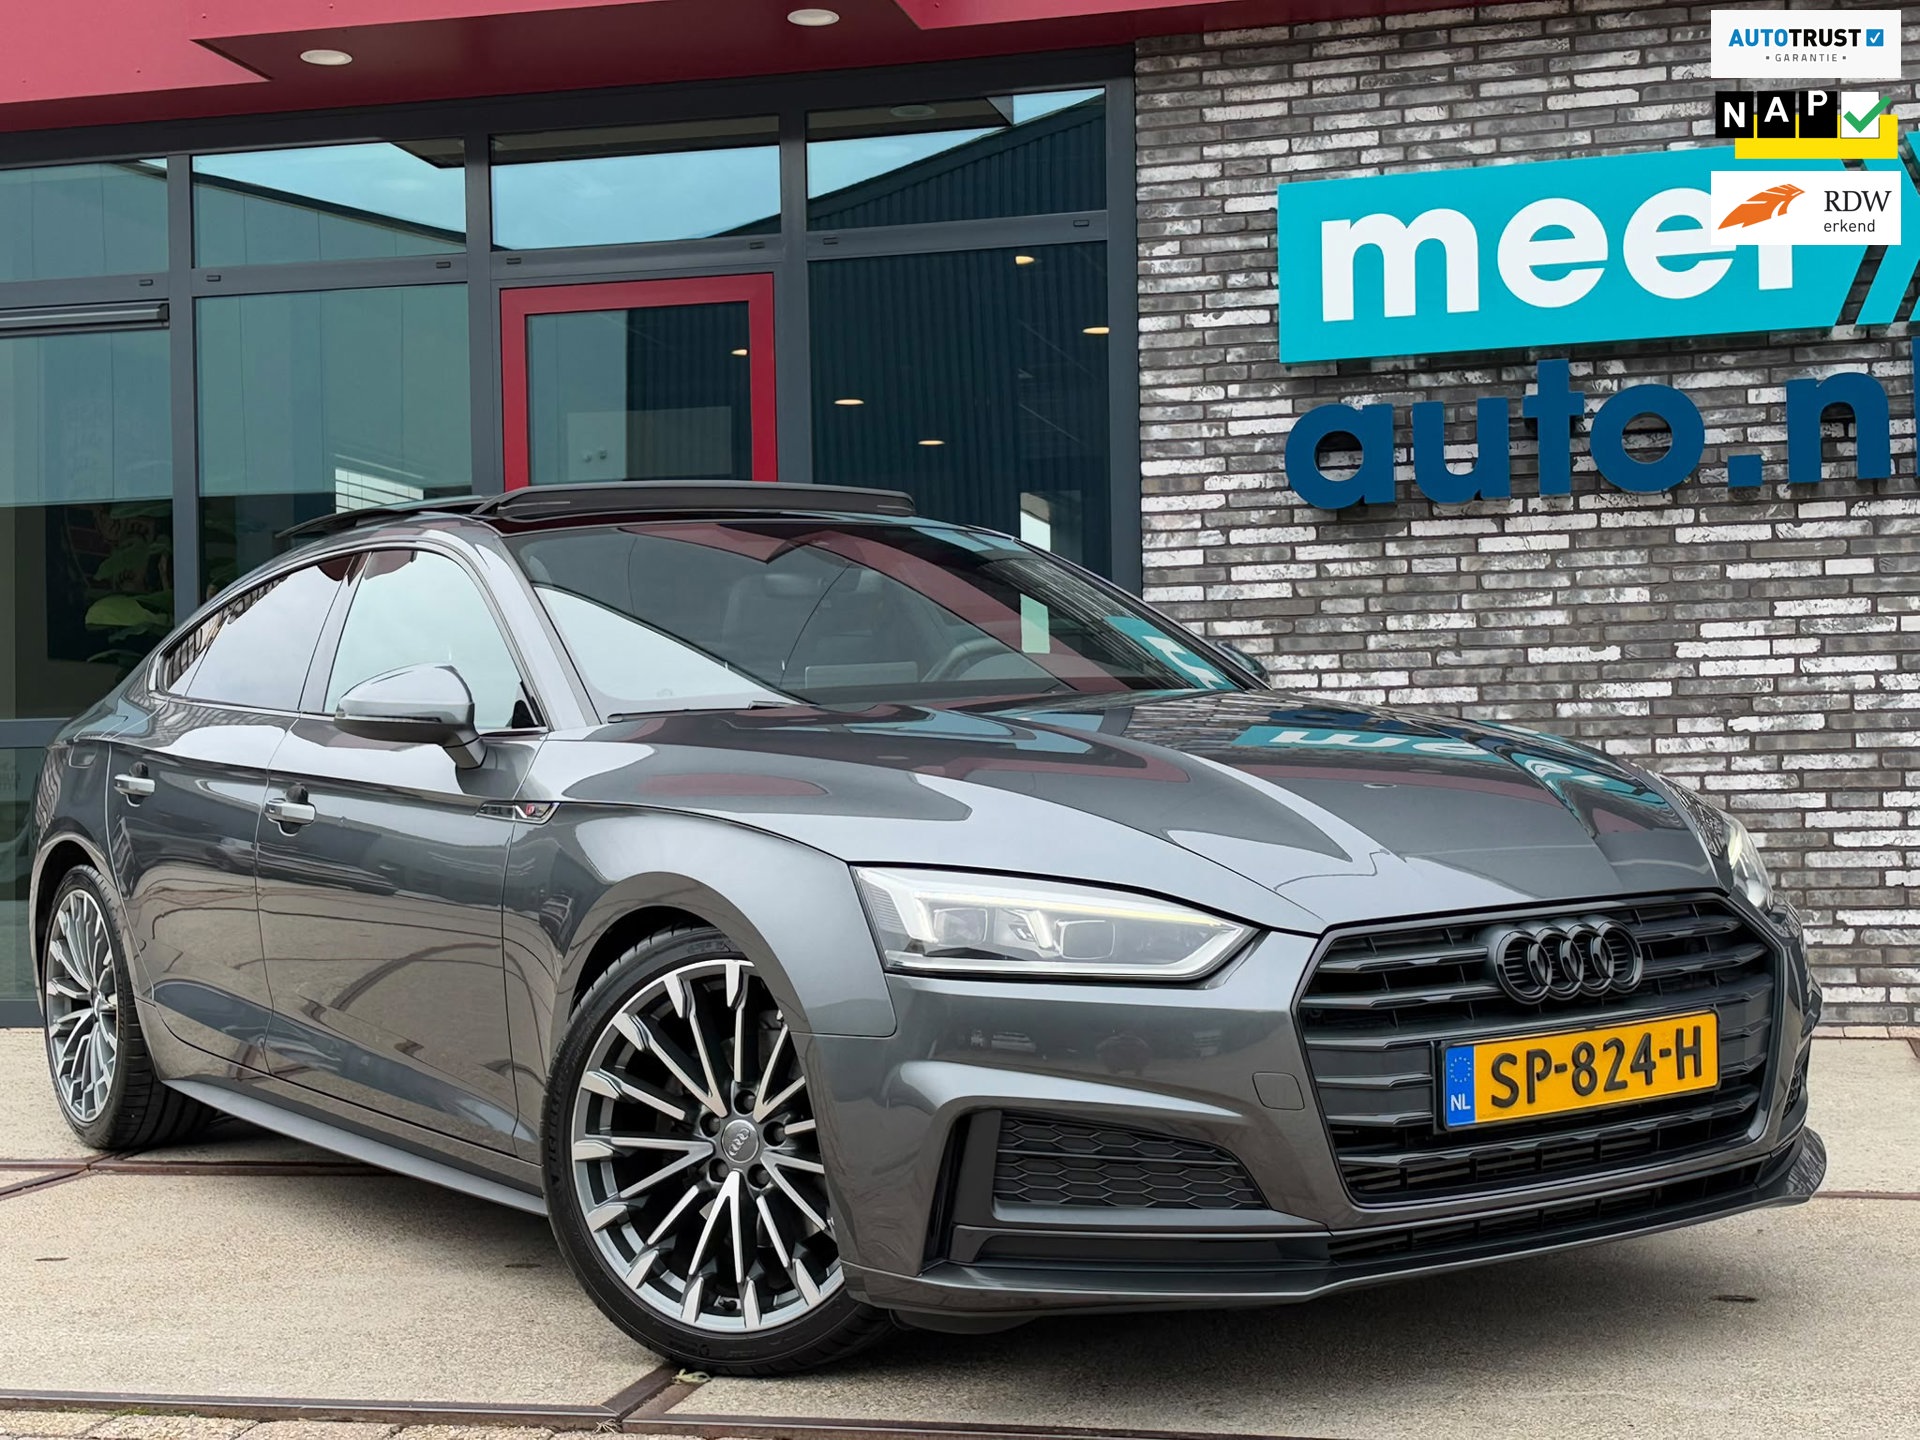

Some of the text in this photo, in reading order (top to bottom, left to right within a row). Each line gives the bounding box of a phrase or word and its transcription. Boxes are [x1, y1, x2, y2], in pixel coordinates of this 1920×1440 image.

[1285, 336, 1920, 510] auto.n
[1450, 1093, 1470, 1111] NL
[1491, 1026, 1702, 1108] SP-824-H
